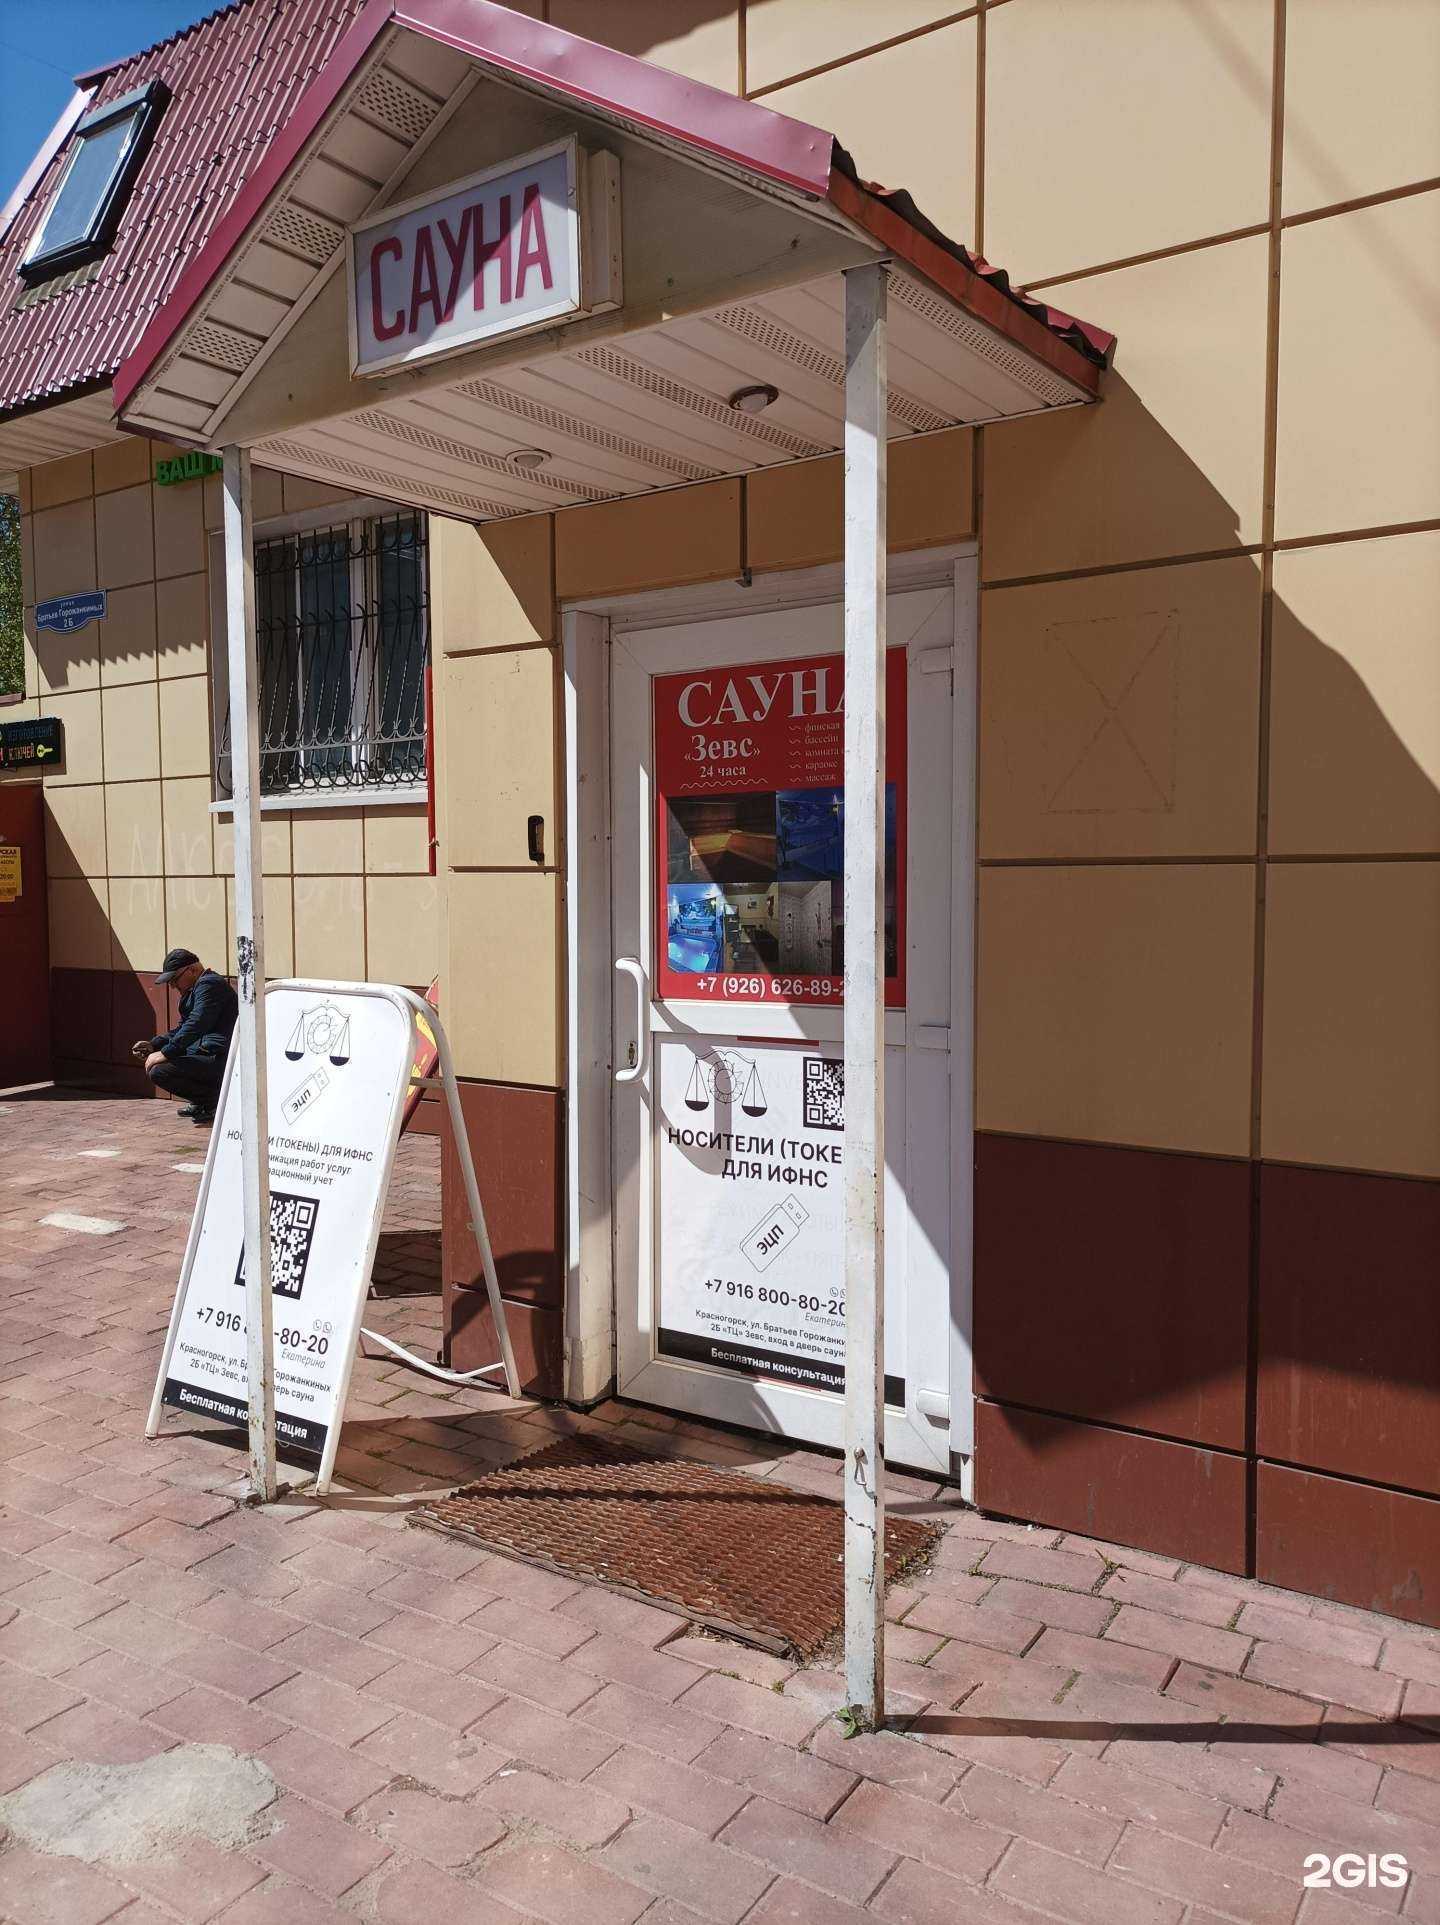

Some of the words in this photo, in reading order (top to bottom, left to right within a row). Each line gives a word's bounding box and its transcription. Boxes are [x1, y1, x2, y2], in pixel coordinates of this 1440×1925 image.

[370, 182, 553, 342] САУНА
[157, 452, 204, 485] ВАШ
[63, 618, 74, 628] 2Б
[684, 734, 761, 761] «Зевс»
[700, 766, 713, 778] 24
[718, 766, 746, 777] часа
[697, 977, 717, 992] +7
[723, 977, 765, 997] (926)
[291, 1089, 312, 1112] ЭЦП
[275, 1137, 320, 1154] (ТОКЕНЫ)
[321, 1144, 342, 1157] ДЛЯ
[343, 1148, 373, 1162] ИФНС
[668, 1127, 774, 1156] НОСИТЕЛИ
[780, 1138, 842, 1164] (ТОКЕ
[268, 1154, 299, 1166] икация
[300, 1158, 325, 1170] работ
[327, 1164, 351, 1176] услуг
[268, 1168, 312, 1181] ационный
[313, 1175, 334, 1185] учет
[722, 1159, 762, 1180] ДЛЯ
[768, 1164, 828, 1188] ИФНС
[756, 1224, 785, 1255] ЭЦП
[705, 1279, 722, 1293] +7
[727, 1281, 754, 1299] 916
[197, 1307, 214, 1324] +7
[215, 1310, 242, 1332] 916
[696, 1309, 748, 1327] Красногорск,
[750, 1321, 762, 1331] ул.
[764, 1322, 797, 1337] Братьев
[799, 1330, 846, 1346] Горожанки
[805, 1312, 846, 1328] Екатерин
[711, 1323, 721, 1332] 2Б
[723, 1325, 743, 1337] «ТЦ»
[745, 1330, 766, 1343] Зевс,
[768, 1337, 788, 1347] вход
[796, 1342, 822, 1354] дверь
[179, 1341, 227, 1364] Красногорск,
[229, 1356, 240, 1367] ул.
[274, 1368, 331, 1392] орожанкиных
[281, 1349, 326, 1369] Екатерина
[711, 1347, 771, 1370] Бесплатная
[190, 1358, 200, 1369] 2Б
[201, 1361, 219, 1374] «ТЦ»
[221, 1367, 240, 1382] Зевс,
[291, 1390, 315, 1402] сауна
[179, 1388, 236, 1415] Бесплатная
